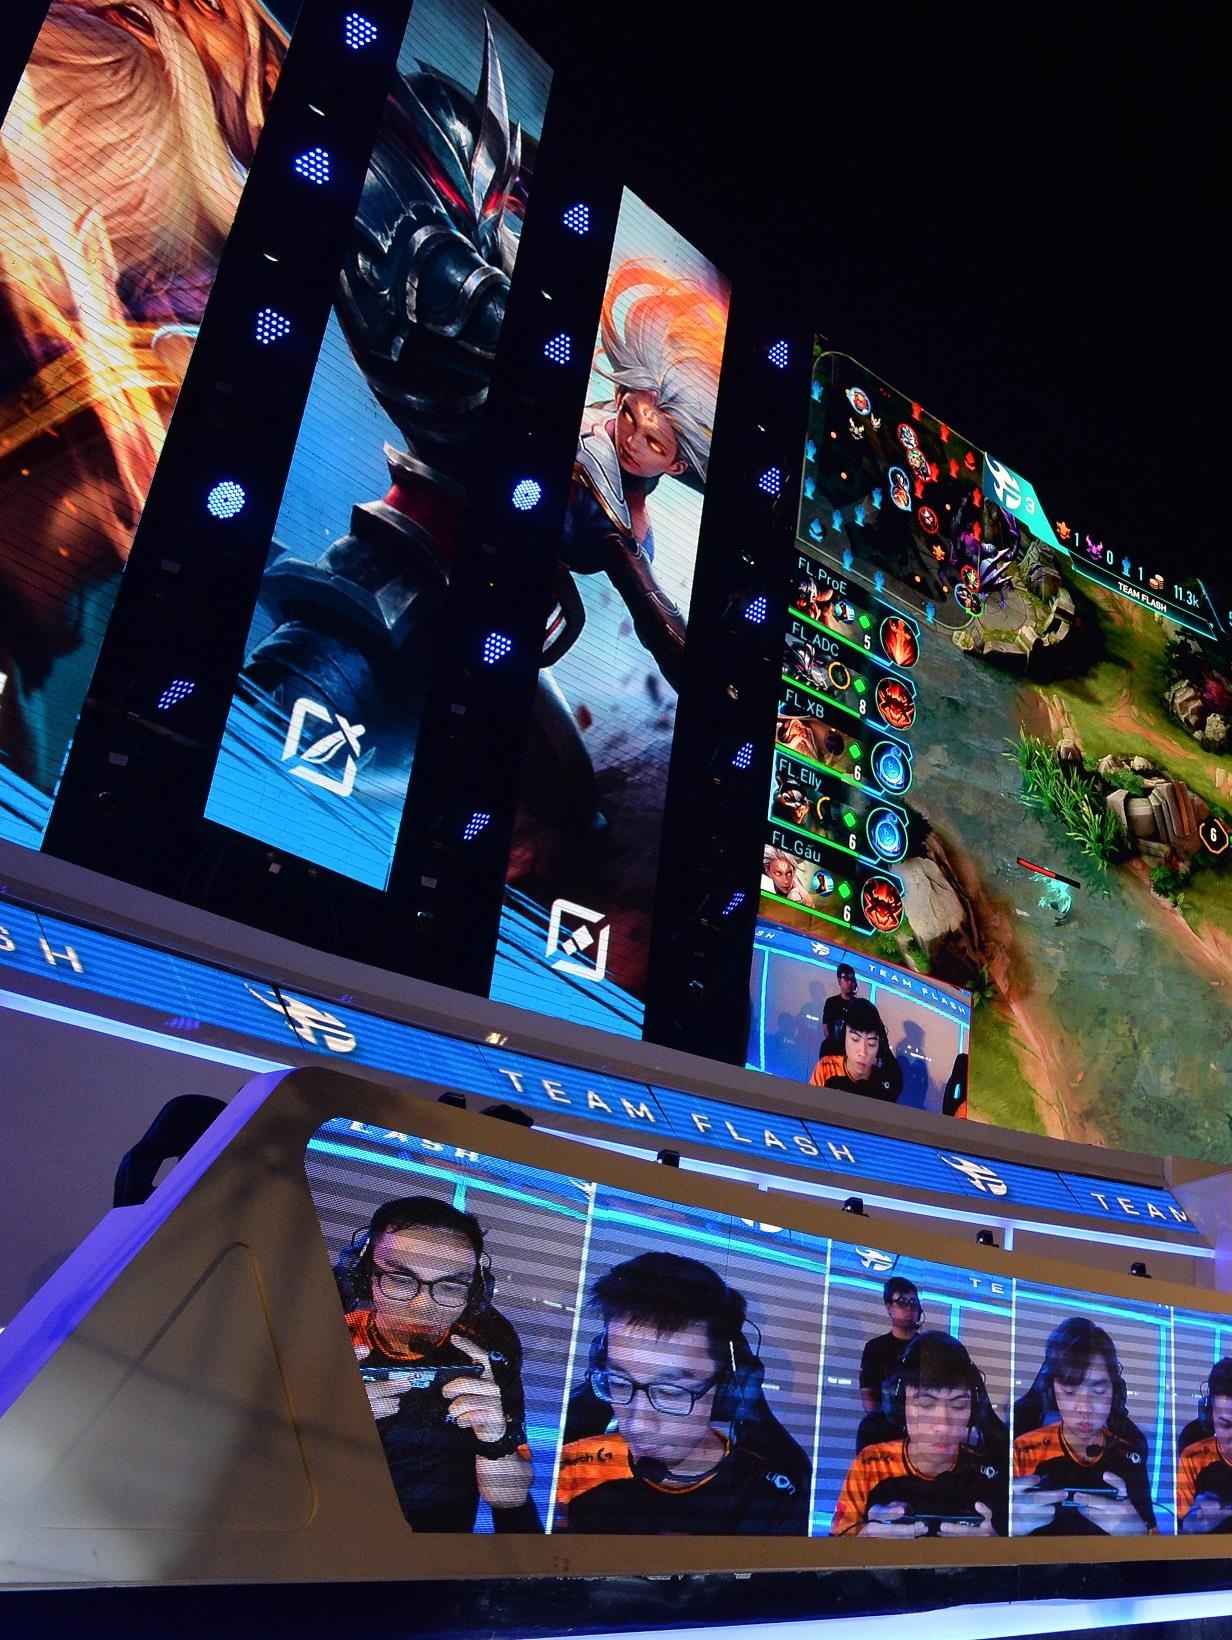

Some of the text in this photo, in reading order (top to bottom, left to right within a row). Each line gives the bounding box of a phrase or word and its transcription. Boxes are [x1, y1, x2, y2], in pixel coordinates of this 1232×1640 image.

[1025, 497, 1036, 514] 3
[798, 556, 848, 595] FL.ProE
[1106, 550, 1113, 565] 0
[1173, 584, 1199, 609] 11.3k
[1117, 581, 1167, 613] TEAM FLASH
[792, 621, 839, 657] FL.ADC
[864, 637, 871, 650] 5
[785, 689, 825, 718] FL.XB
[859, 700, 867, 714] 8
[779, 758, 822, 791] FL.Elly
[854, 765, 861, 781] 6
[849, 834, 856, 850] 6
[1210, 827, 1217, 842] 6
[843, 904, 851, 922] 6
[869, 964, 912, 989] TEAM
[499, 1068, 856, 1164] TEAM FLASH
[345, 1119, 479, 1162] LASH
[968, 1277, 1005, 1295] TE
